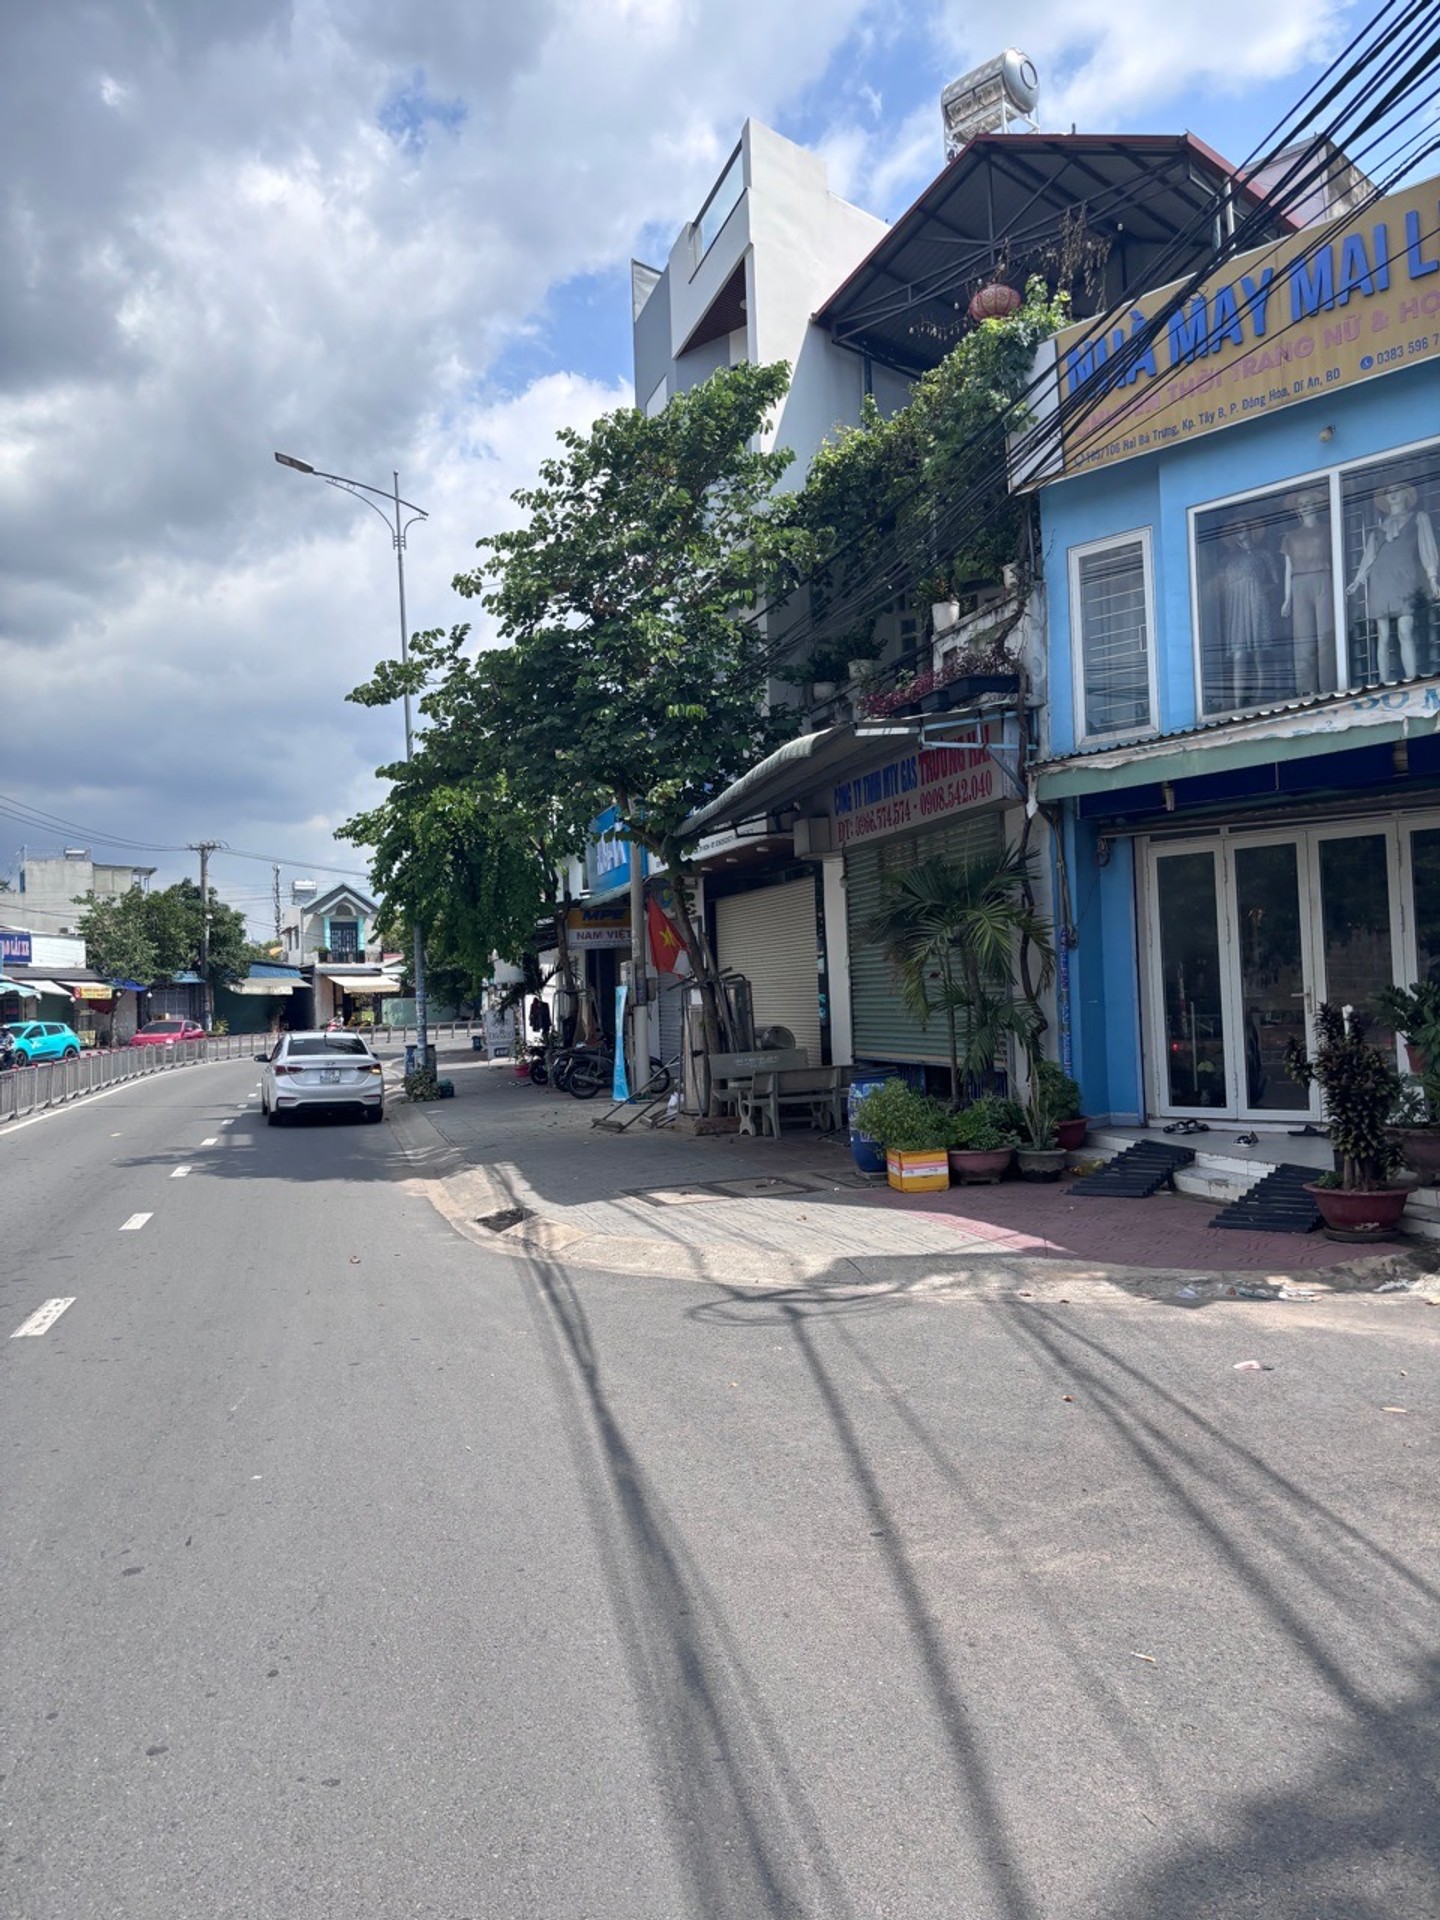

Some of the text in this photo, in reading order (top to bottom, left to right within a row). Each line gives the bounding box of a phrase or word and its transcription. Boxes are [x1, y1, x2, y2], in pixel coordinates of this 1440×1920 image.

[1168, 267, 1274, 368] MAY
[1290, 223, 1391, 323] MAI
[1405, 203, 1440, 280] L
[1231, 335, 1316, 382] TRANG
[1324, 314, 1363, 349] NỮ
[1372, 309, 1390, 333] &
[1377, 345, 1405, 365] 0383
[1408, 337, 1429, 354] 596
[1182, 418, 1197, 432] Kp.
[1198, 409, 1215, 425] Tây
[1229, 402, 1239, 415] P.
[1306, 375, 1323, 389] An,
[900, 755, 918, 793] GAS
[919, 770, 993, 816] 0908.542.040
[575, 930, 603, 941] NAM
[581, 908, 625, 921] MPE
